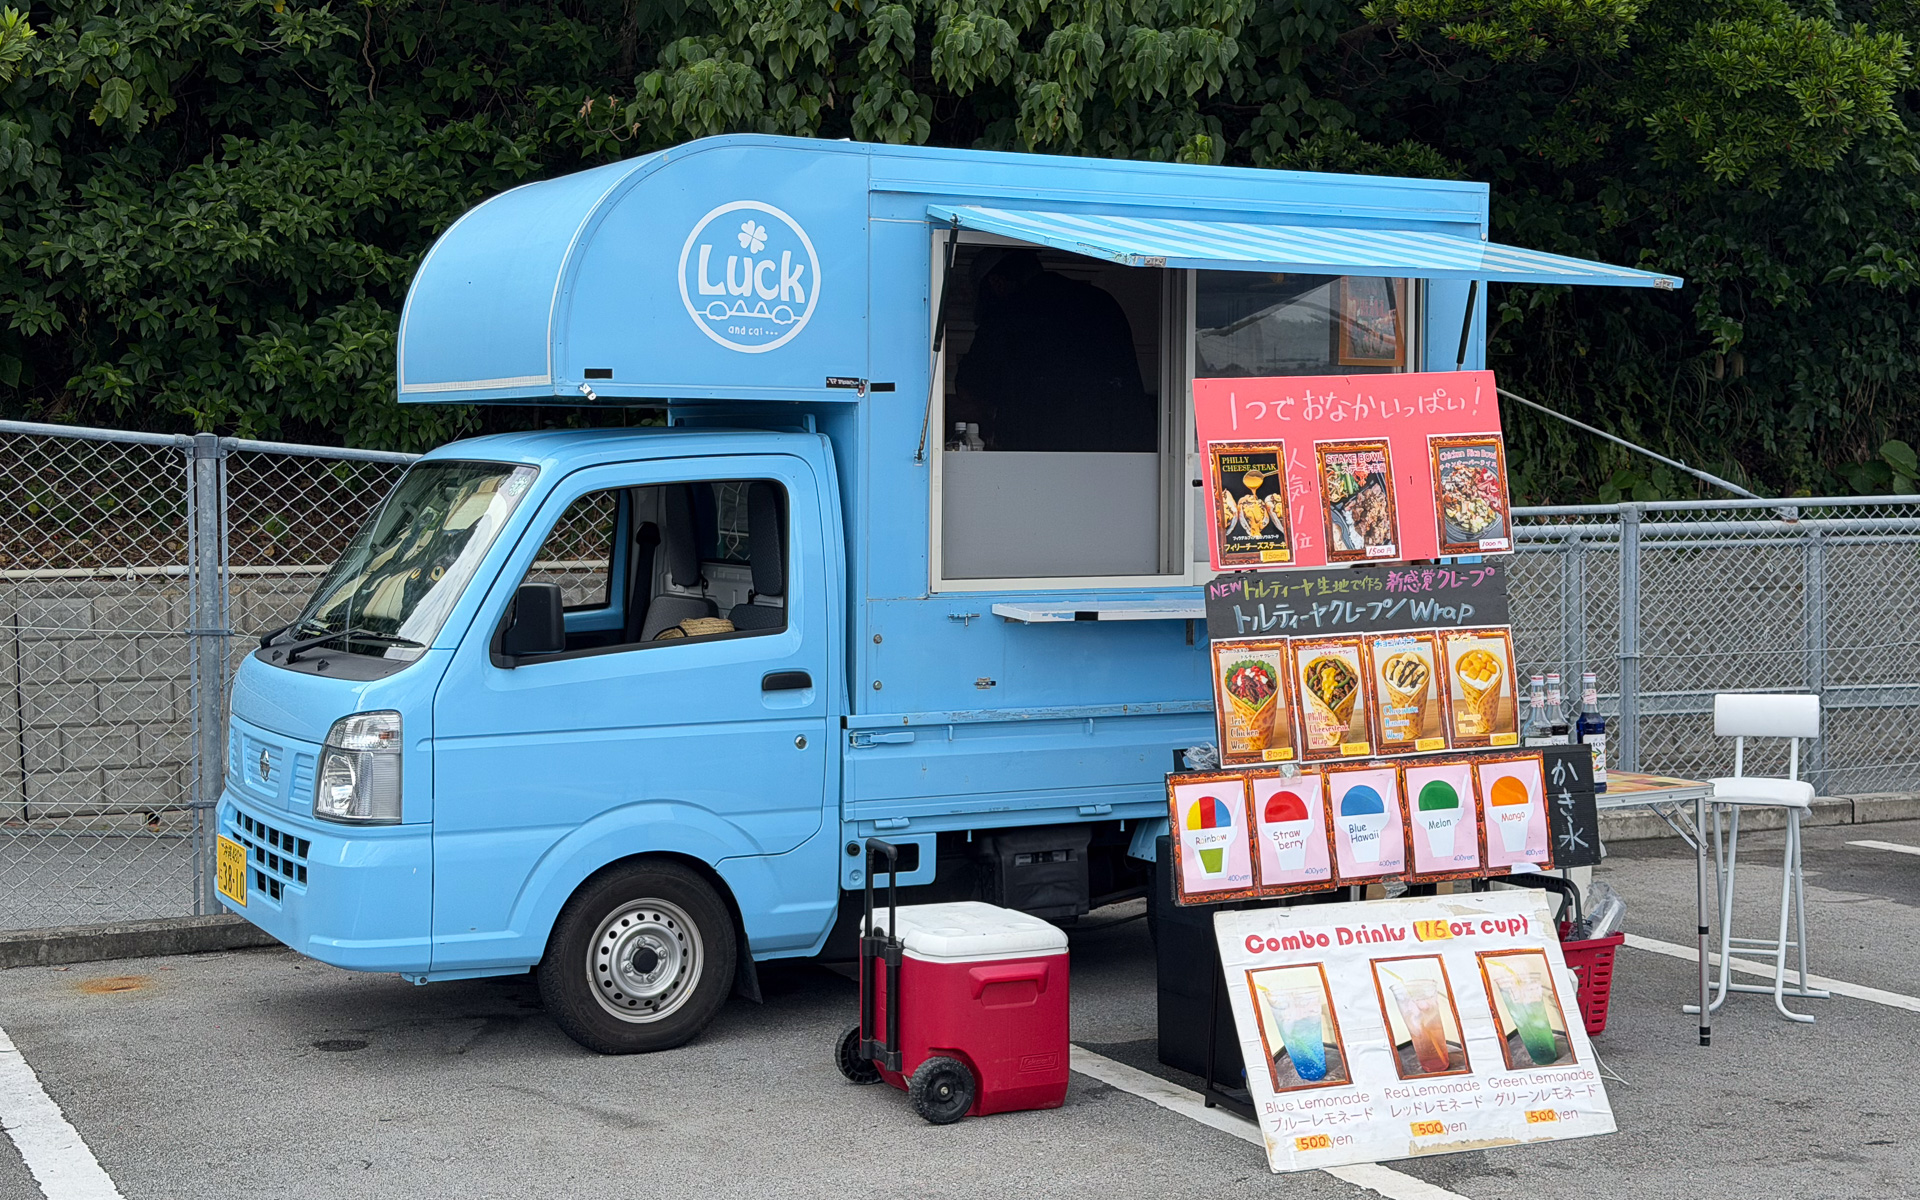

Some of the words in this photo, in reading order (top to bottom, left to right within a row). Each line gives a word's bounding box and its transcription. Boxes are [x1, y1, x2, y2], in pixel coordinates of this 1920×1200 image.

[698, 244, 805, 304] Luck
[728, 325, 746, 336] and
[1221, 456, 1250, 465] PHILLY
[1325, 454, 1357, 464] STAKE
[1358, 451, 1386, 462] BOWL
[1222, 464, 1251, 473] CHEESE
[1252, 463, 1277, 472] STEAK
[1341, 463, 1387, 475] ステーキ弁当
[1224, 541, 1287, 552] フィリーチーズステーキ
[1210, 580, 1242, 600] NEW
[1230, 727, 1260, 738] Chicken
[1231, 741, 1250, 750] Wrap
[1311, 737, 1328, 746] Wrap
[1266, 751, 1290, 759] 800円
[1551, 758, 1589, 851] かき氷
[1501, 811, 1526, 822] Mango
[1348, 823, 1367, 834] Blue
[1428, 818, 1452, 830] Melon
[1195, 833, 1227, 845] Rainbow
[1273, 830, 1301, 841] Straw
[1350, 830, 1380, 844] Hawaii
[1278, 839, 1304, 850] berry
[1304, 867, 1328, 875] 400yen
[1227, 874, 1251, 882] 400yen
[1245, 930, 1330, 954] Combo
[1335, 923, 1406, 946] Drinks
[1480, 914, 1529, 937] cup)
[1488, 1076, 1528, 1089] Green
[1529, 1069, 1594, 1085] Lemonade
[1384, 1086, 1410, 1099] Red
[1411, 1080, 1480, 1097] Lemonade
[1494, 1084, 1596, 1107] グリーンレモネード
[1265, 1102, 1294, 1114] Blue
[1296, 1091, 1370, 1110] Lemonade
[1390, 1094, 1483, 1118] レッドレモネード
[1270, 1107, 1374, 1133] ブルーレモネード
